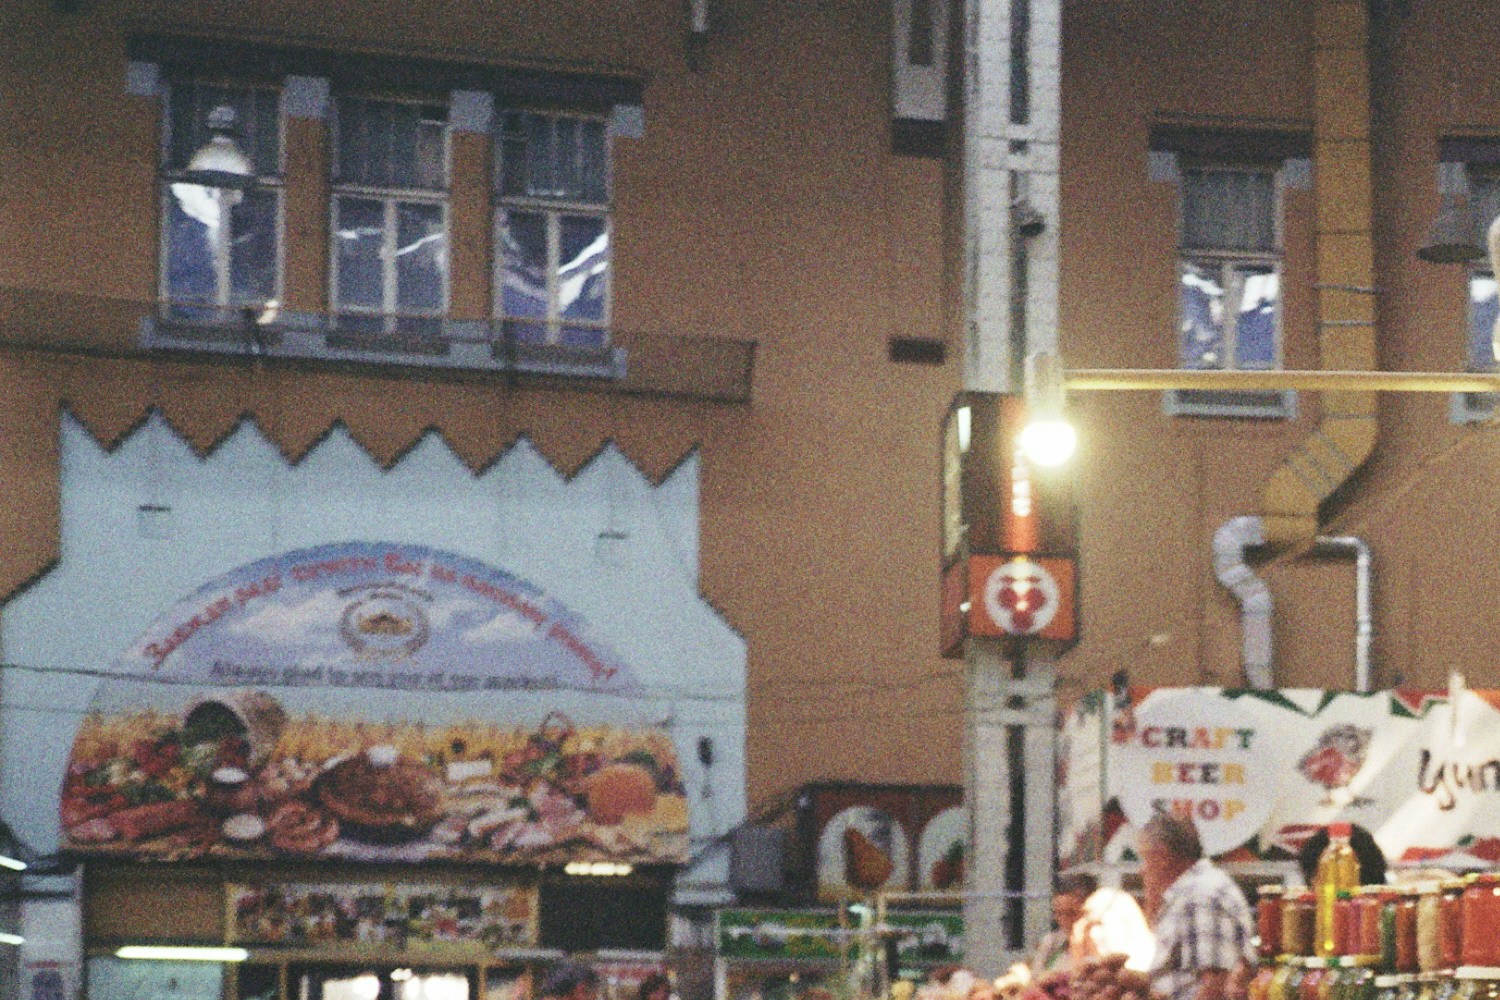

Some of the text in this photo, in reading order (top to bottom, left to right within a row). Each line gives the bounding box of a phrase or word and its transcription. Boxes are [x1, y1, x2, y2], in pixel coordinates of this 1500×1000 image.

[1141, 726, 1256, 750] CRAFT
[1151, 761, 1246, 785] BEER
[1151, 797, 1246, 822] SHOP
